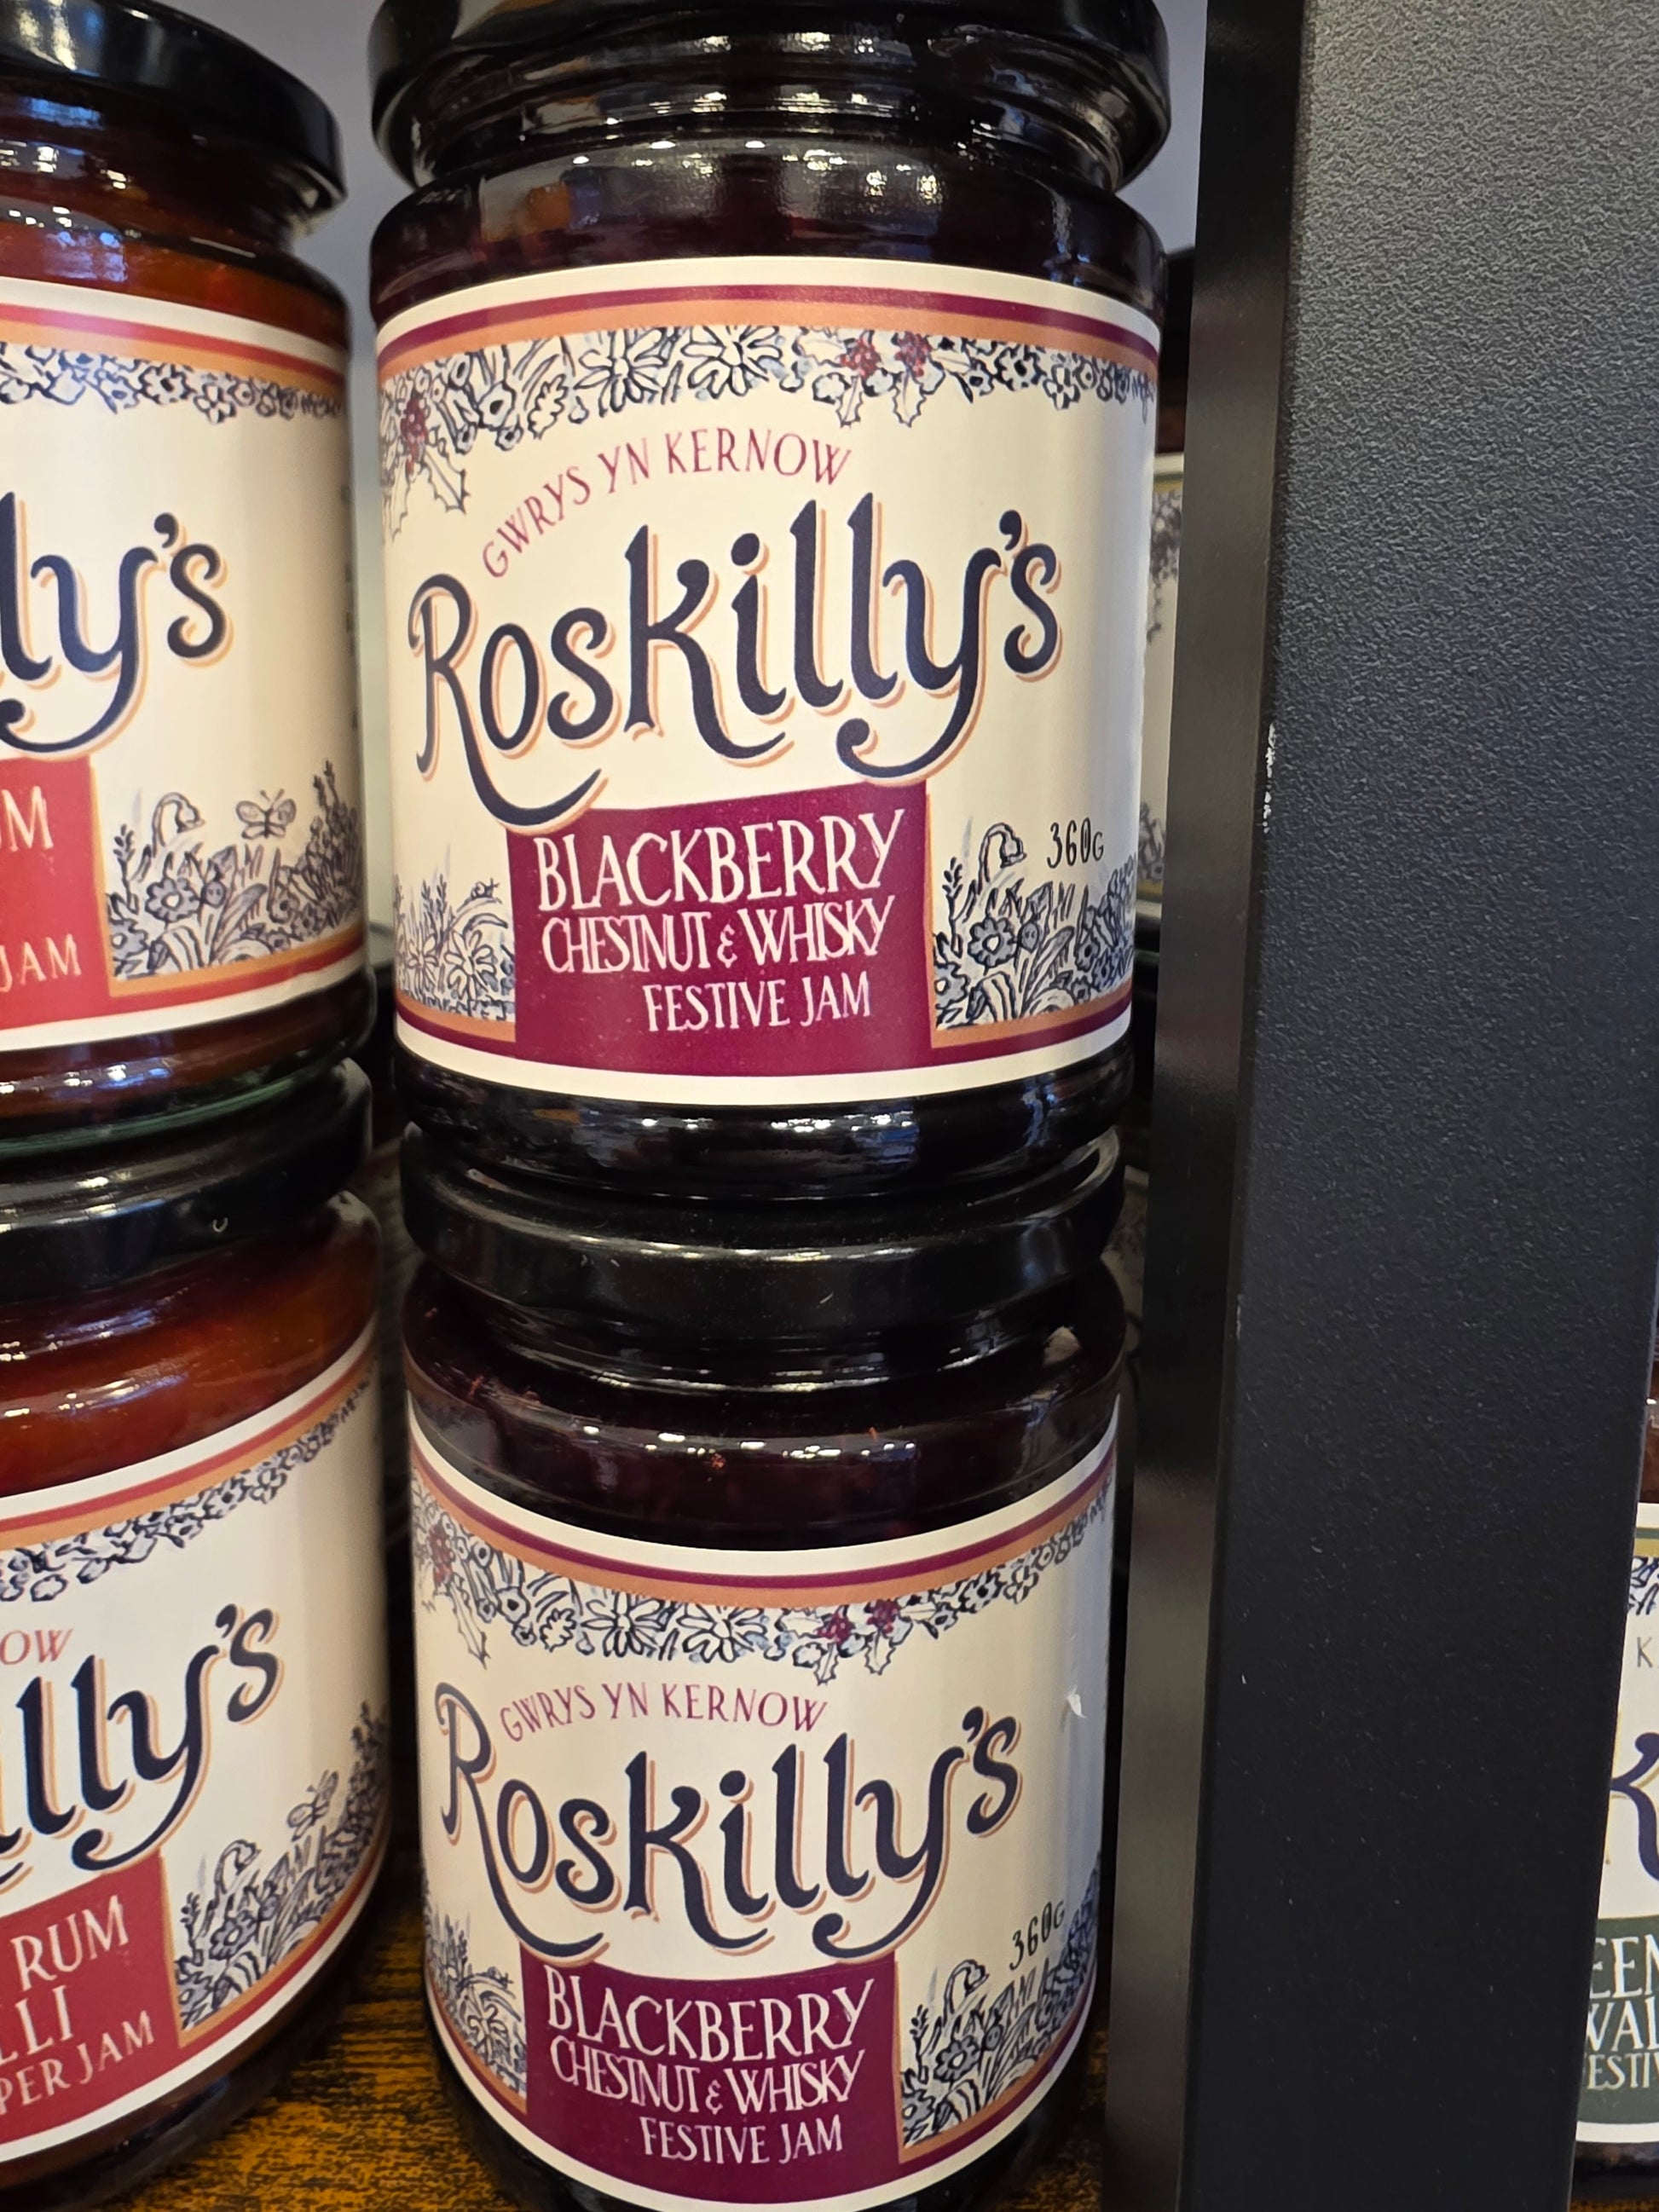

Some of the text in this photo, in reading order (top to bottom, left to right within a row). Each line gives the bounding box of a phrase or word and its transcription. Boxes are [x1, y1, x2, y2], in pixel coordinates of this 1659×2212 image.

[482, 427, 853, 579] GWRYS YN KERNOW
[408, 492, 1063, 832] Roskilly's
[533, 808, 909, 912] BLACKBERRY
[541, 895, 896, 974] CHESTNUT & WHISKY
[643, 971, 873, 1032] FESTIVE JAM
[500, 1682, 830, 1742] GWRYS YN KERNOW
[434, 1681, 1024, 1964] Roskilly's
[9, 1894, 129, 1992] RUM
[77, 2009, 155, 2085] JAM
[543, 1964, 876, 2064] BLACKBERRY
[550, 2035, 867, 2116] CHESTNUT & WHISKY
[639, 2114, 844, 2166] FESTIVE JAM
